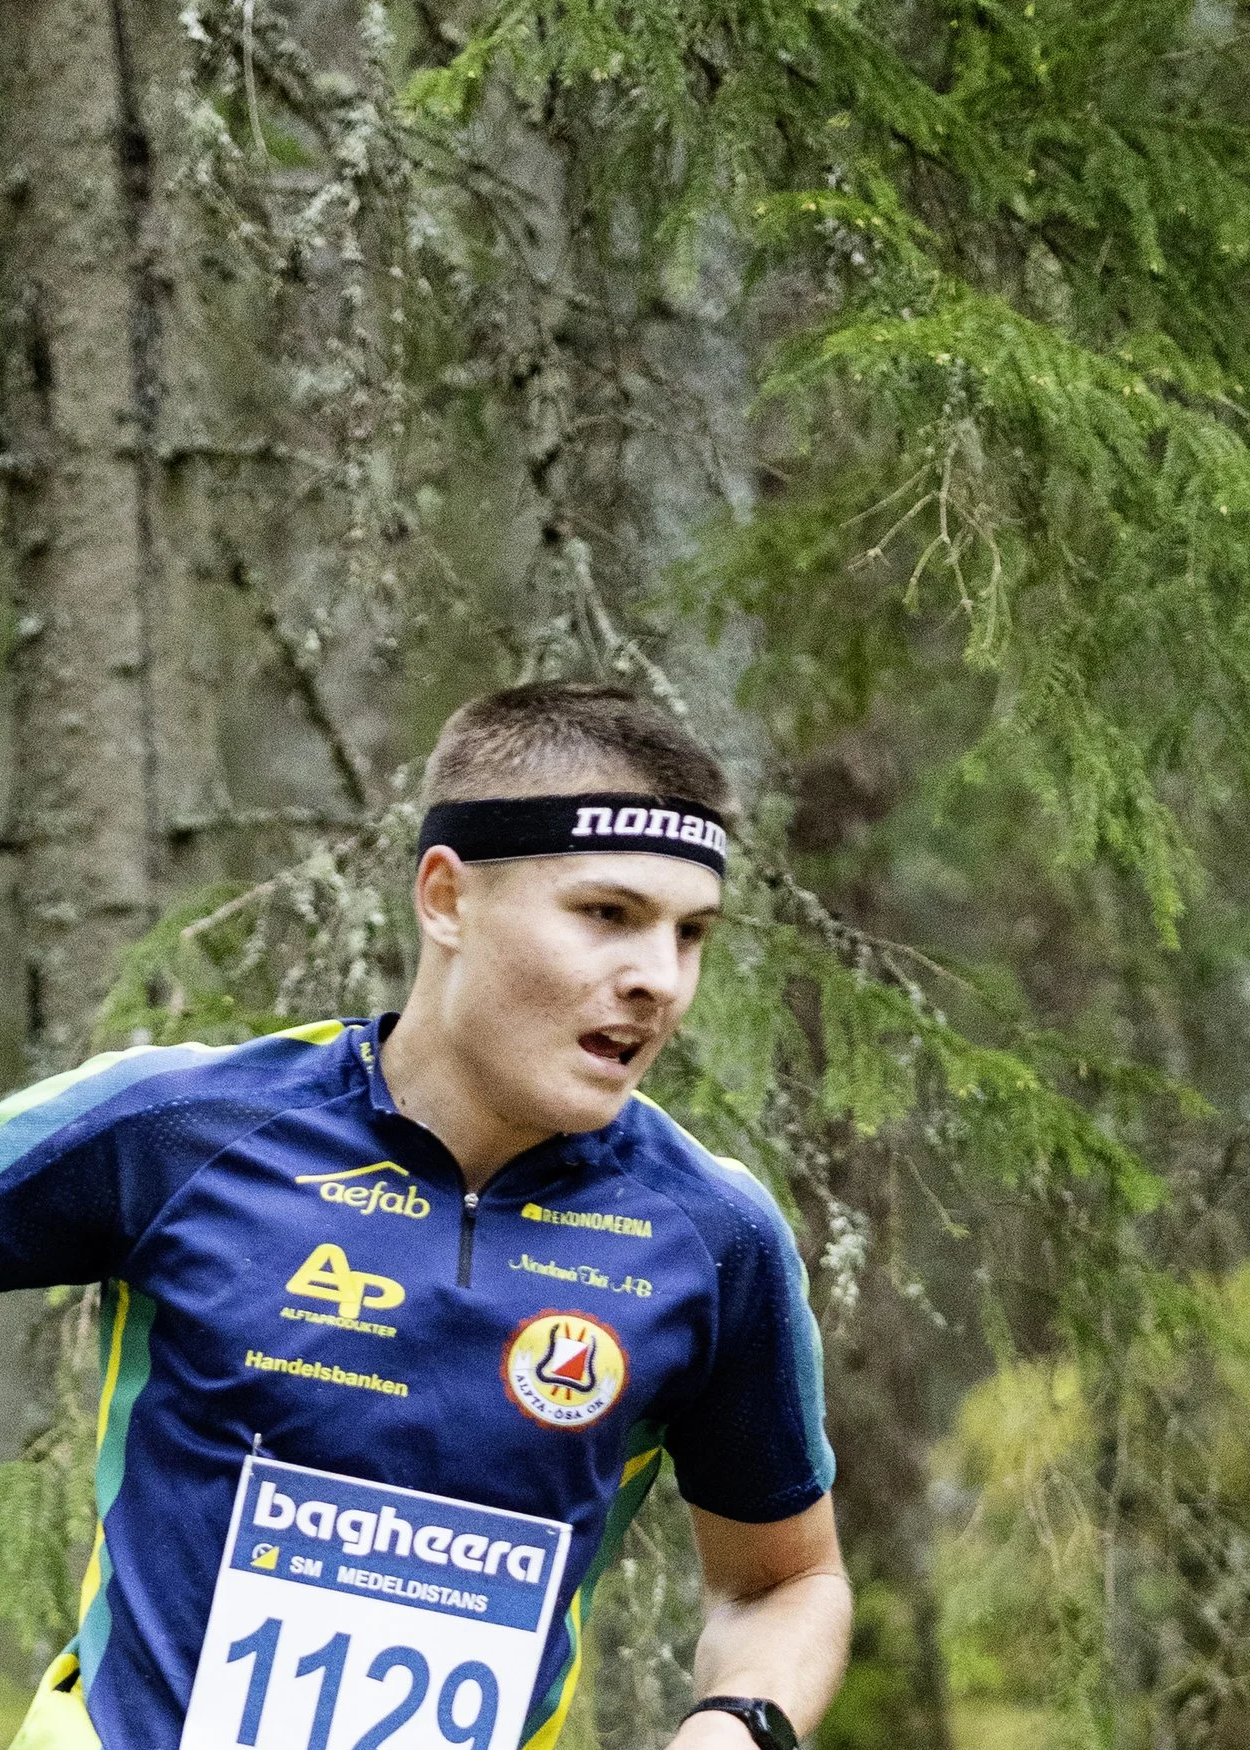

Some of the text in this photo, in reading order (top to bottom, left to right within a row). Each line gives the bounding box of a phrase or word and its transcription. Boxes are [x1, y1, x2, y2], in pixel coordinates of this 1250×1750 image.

[320, 1181, 431, 1219] aefab
[285, 1243, 406, 1319] AP
[245, 1350, 409, 1398] Handelsbanken
[586, 1397, 605, 1414] OK
[253, 1481, 546, 1584] bagheera
[289, 1555, 488, 1613] SM MEDELDISTANS
